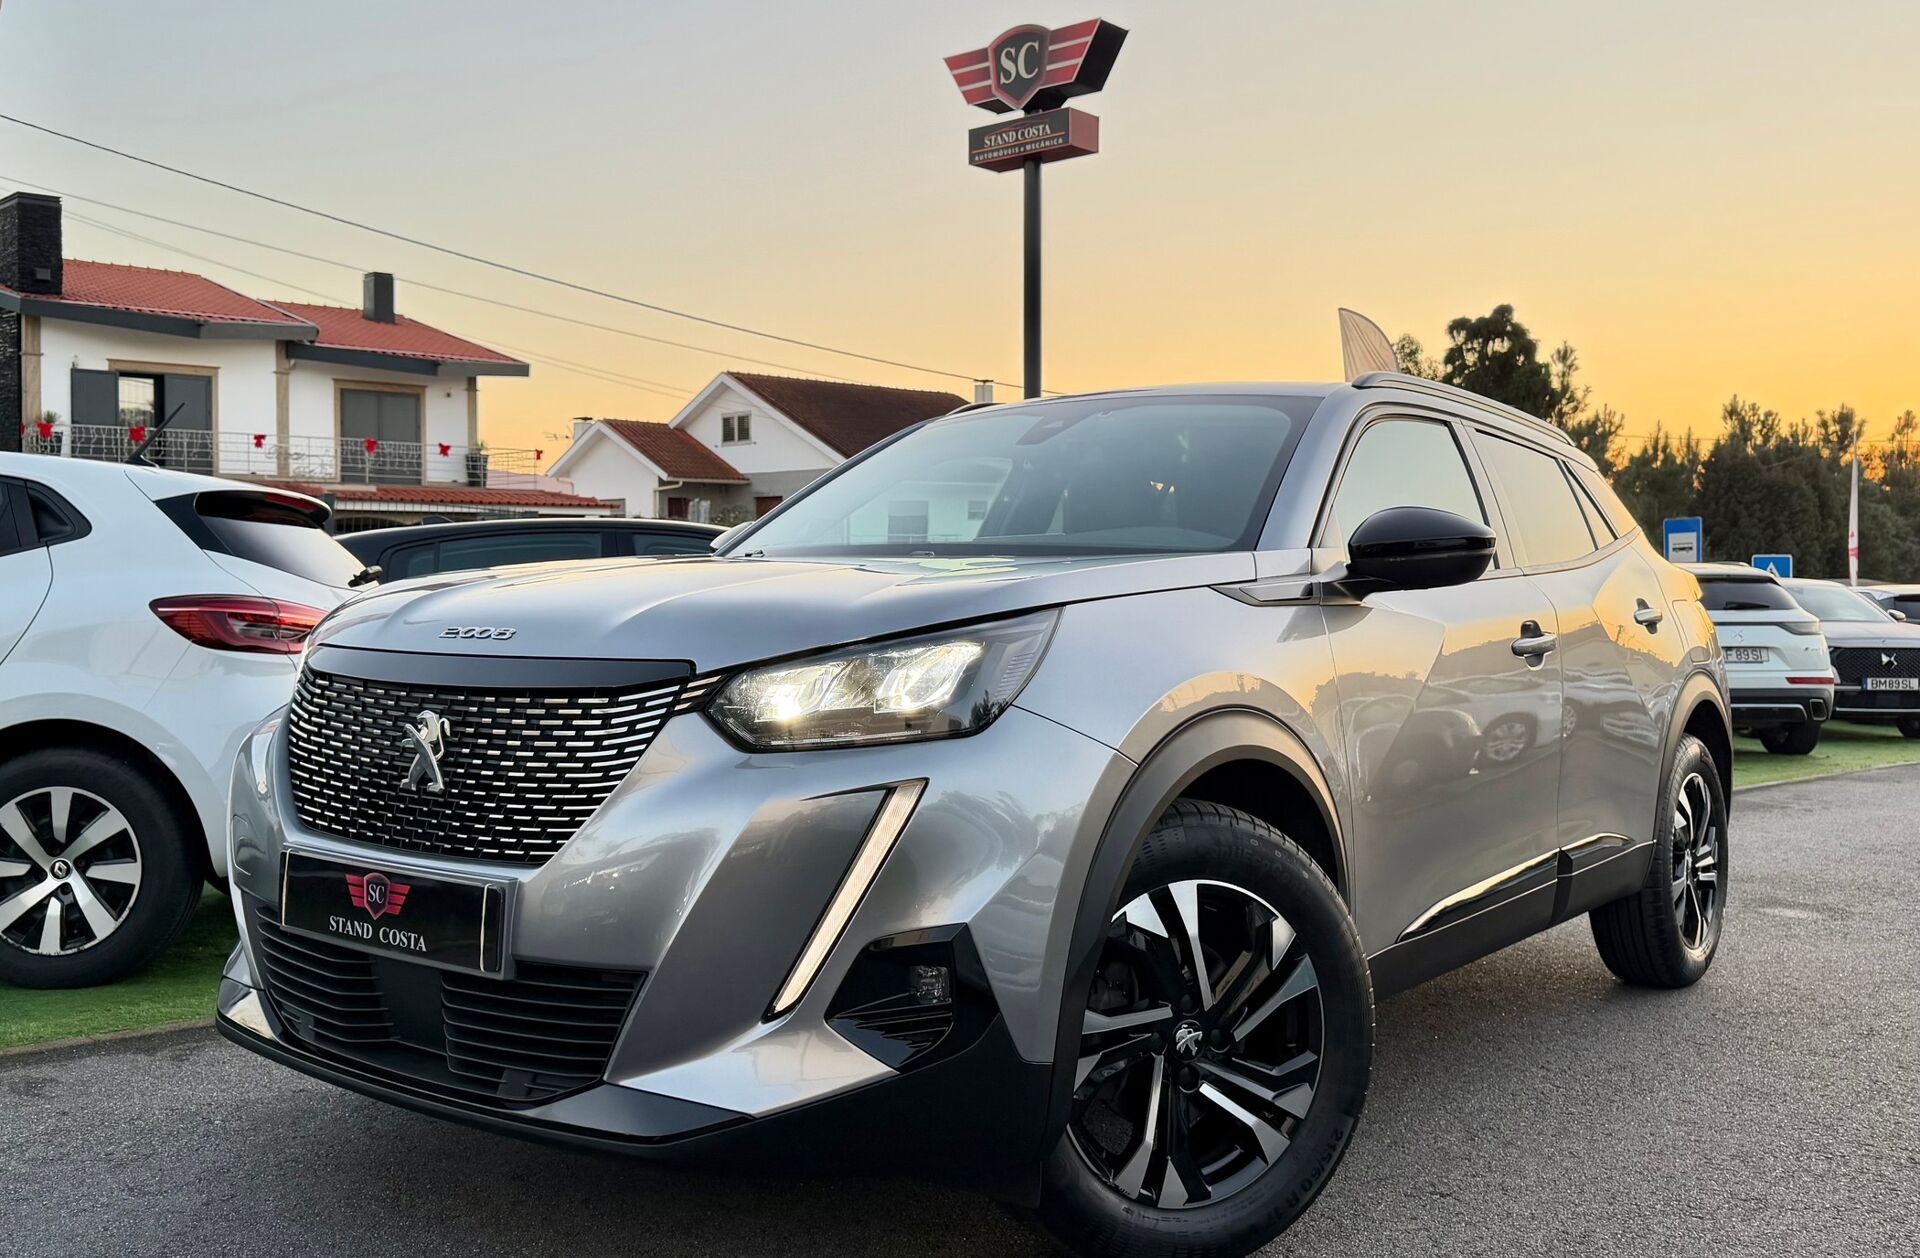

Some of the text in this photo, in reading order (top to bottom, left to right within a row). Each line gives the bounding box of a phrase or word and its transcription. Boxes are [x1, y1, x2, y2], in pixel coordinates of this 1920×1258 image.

[1000, 41, 1040, 84] SC
[984, 124, 1051, 148] STAND COSTA
[438, 627, 517, 640] 2008
[368, 884, 385, 904] SC
[329, 915, 427, 951] STAND COSTA
